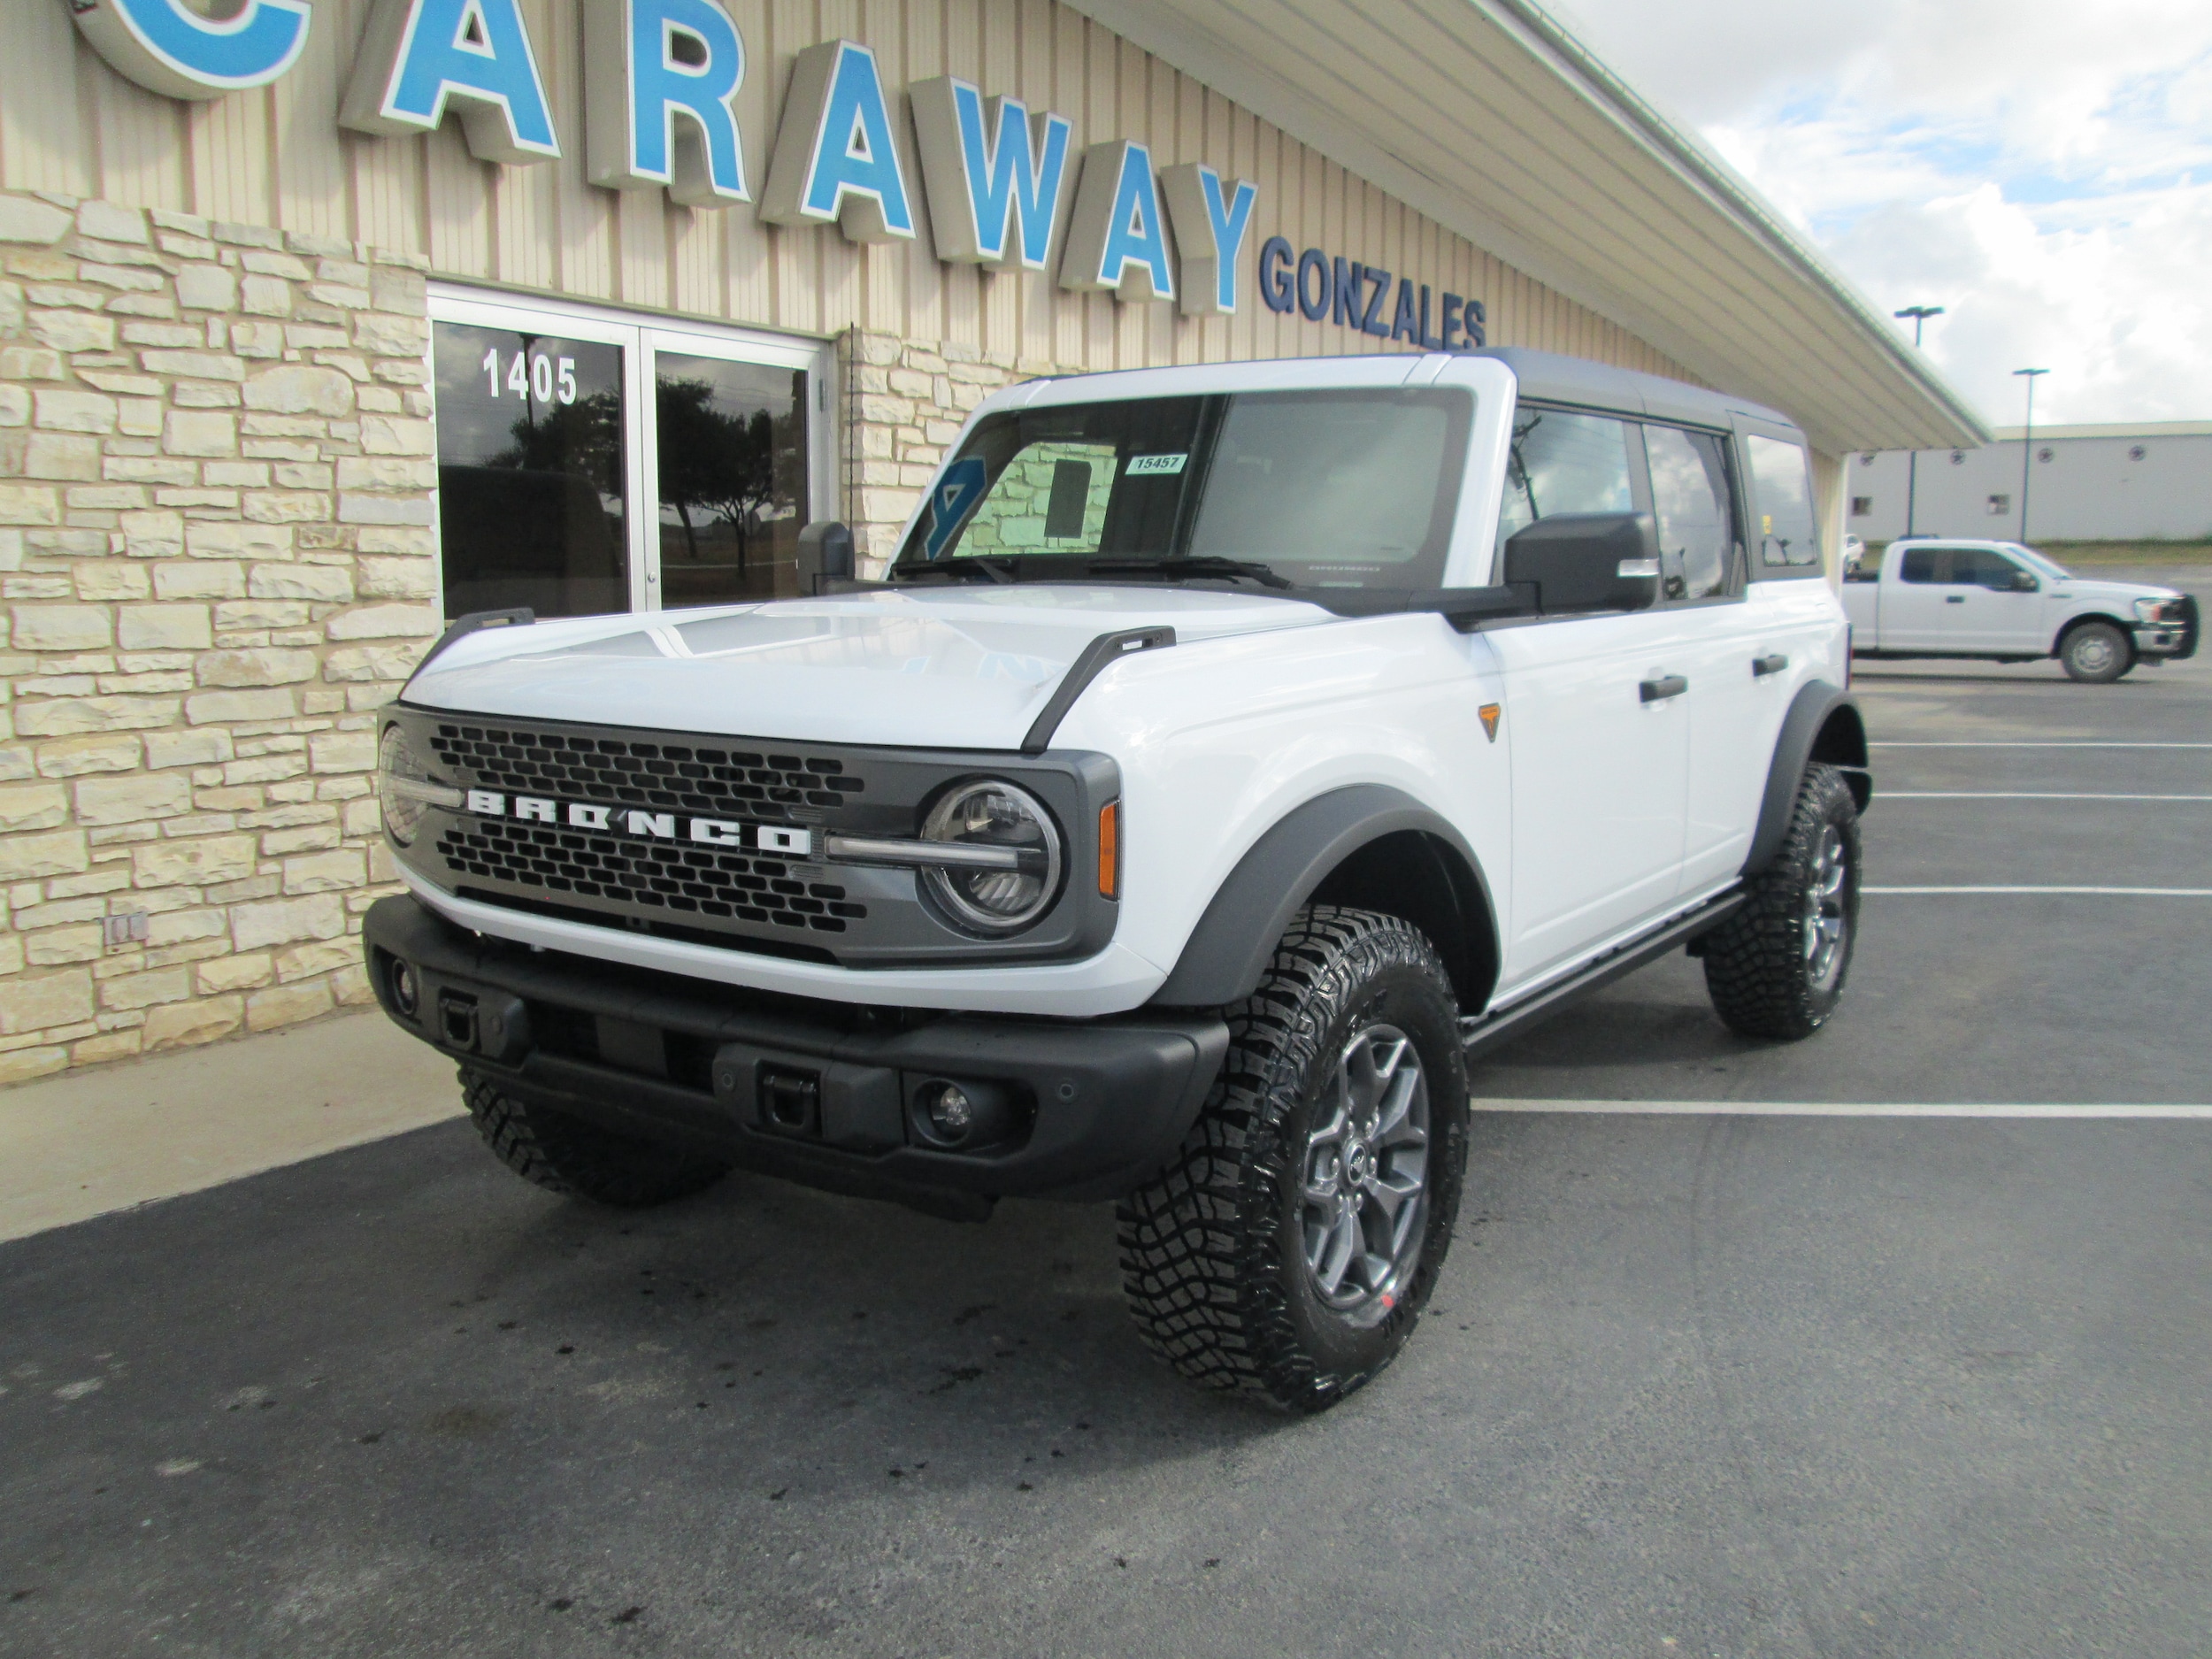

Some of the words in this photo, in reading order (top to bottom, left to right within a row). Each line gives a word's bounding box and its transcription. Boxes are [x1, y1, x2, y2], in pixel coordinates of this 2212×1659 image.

[1259, 235, 1486, 350] GONZALES
[483, 348, 577, 405] 1405
[1137, 457, 1179, 469] 15457
[467, 789, 811, 855] BRONCO
